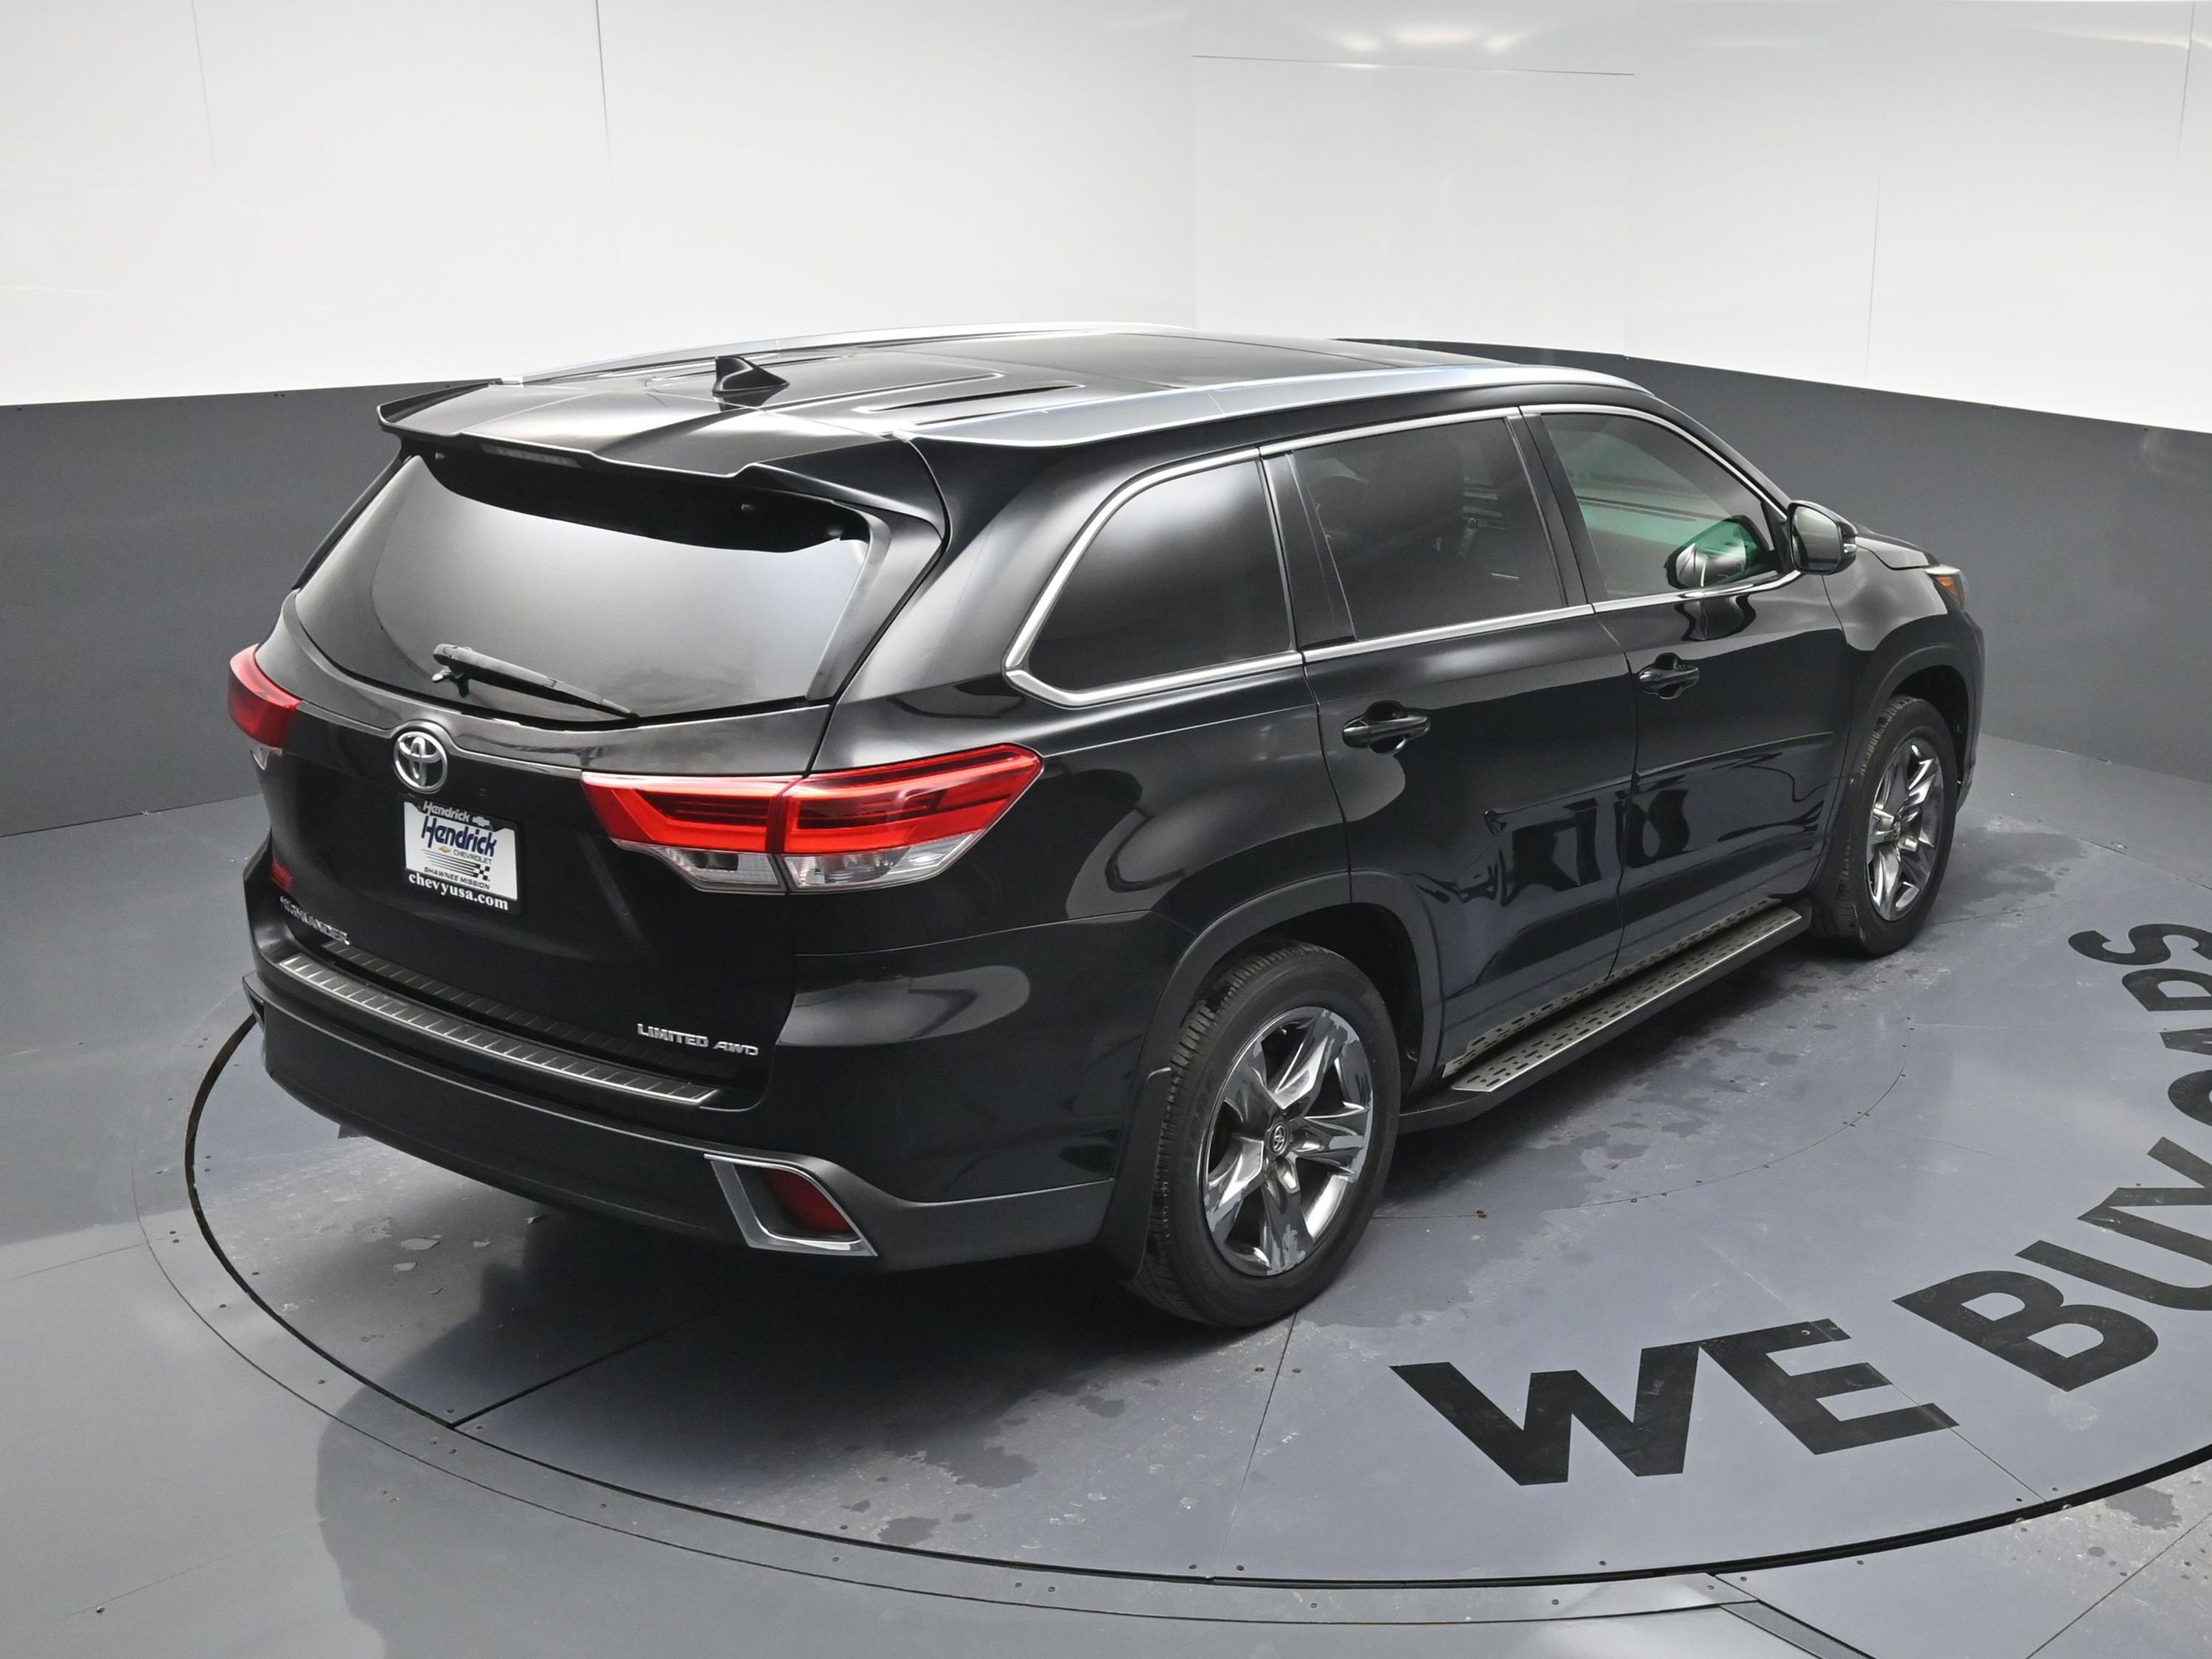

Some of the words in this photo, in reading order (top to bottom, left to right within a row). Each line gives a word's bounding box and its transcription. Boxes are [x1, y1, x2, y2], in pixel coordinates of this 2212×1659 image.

[422, 801, 470, 822] Hendrick
[421, 815, 497, 857] Hendrick
[453, 849, 493, 865] CHEVROLET
[408, 872, 509, 911] chevyusa.com
[424, 866, 459, 881] SHAWNEE
[459, 877, 490, 890] MISSION
[637, 1023, 709, 1048] LIMITED
[712, 1040, 759, 1056] AWD
[1388, 1318, 1961, 1486] WE
